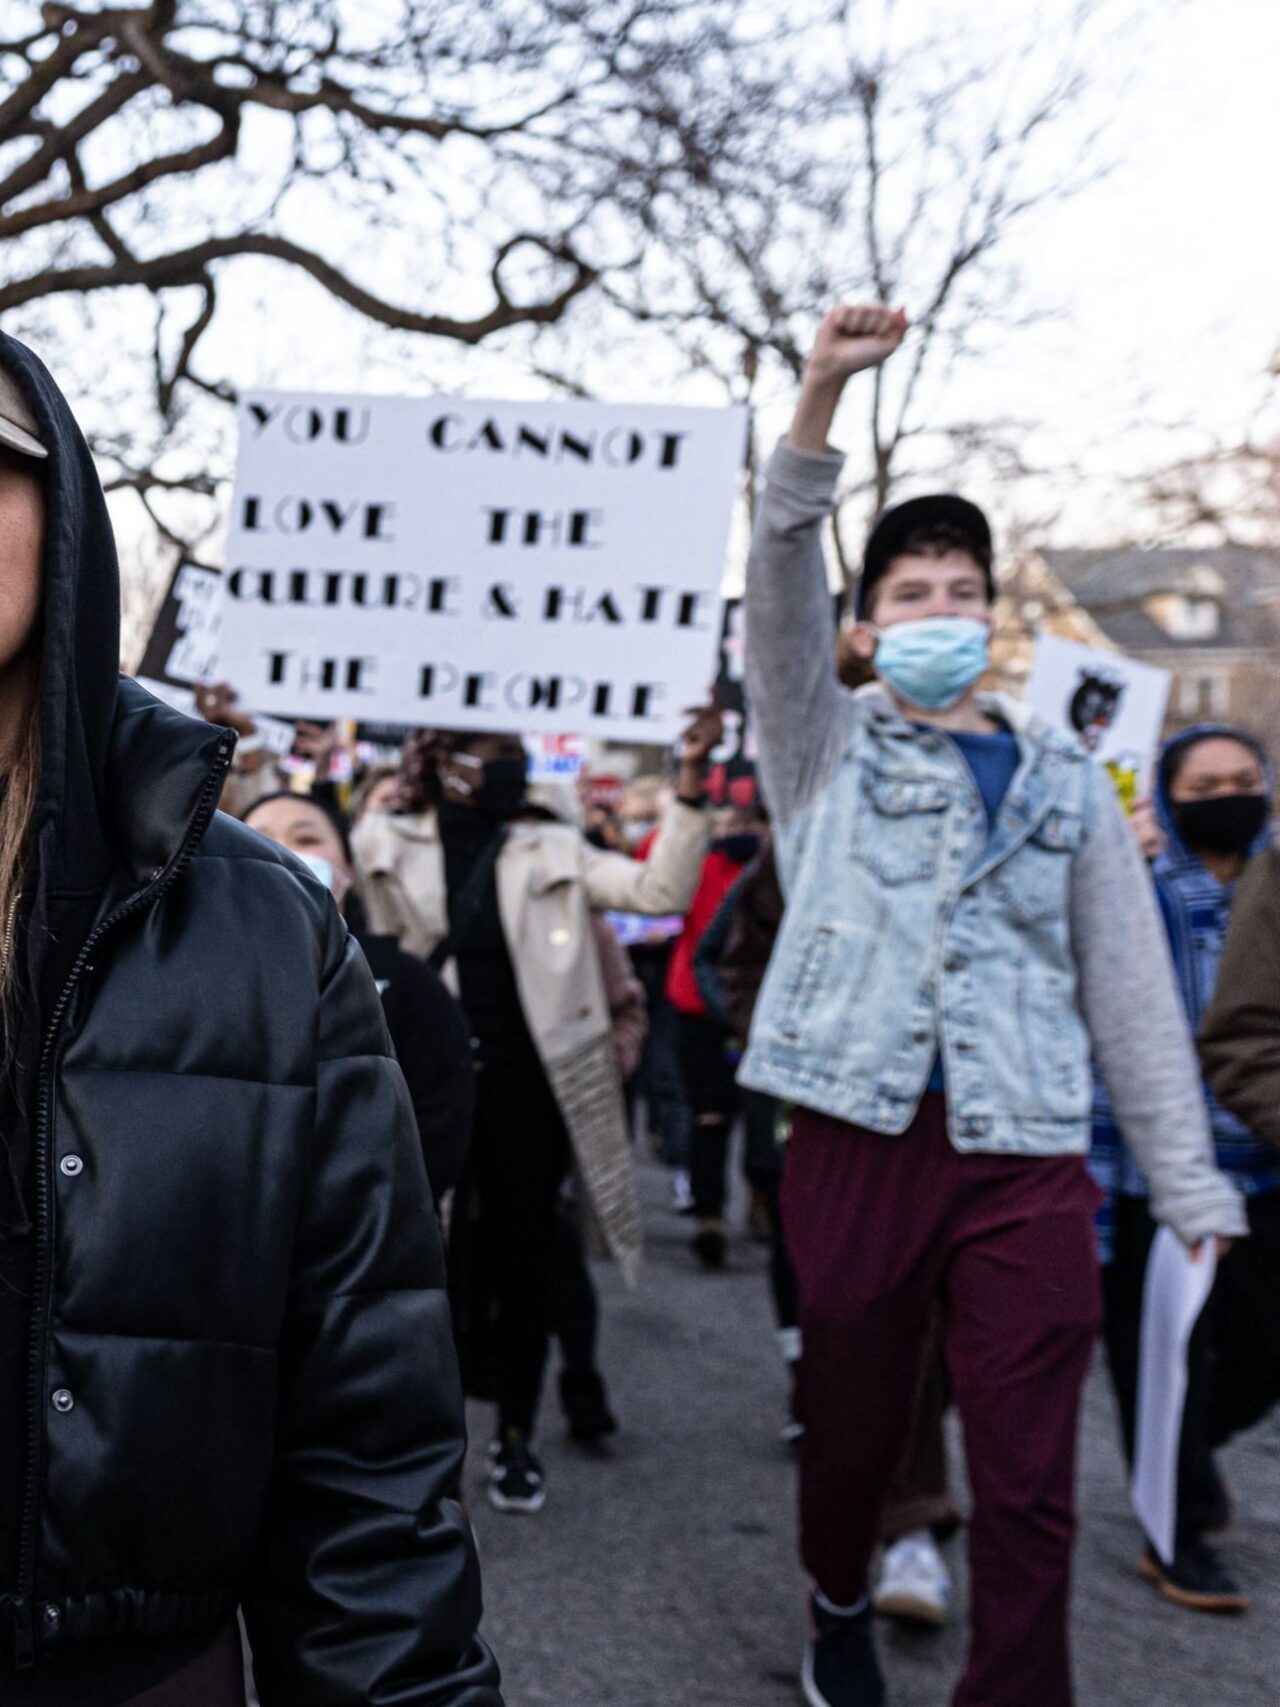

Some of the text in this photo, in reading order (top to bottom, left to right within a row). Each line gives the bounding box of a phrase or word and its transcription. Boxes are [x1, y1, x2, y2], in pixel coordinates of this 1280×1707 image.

[248, 401, 695, 471] YOU CANNOT
[241, 496, 604, 548] LOVE THE
[227, 566, 712, 629] CULTURE & HATE
[262, 650, 669, 722] THE PEOPLE
